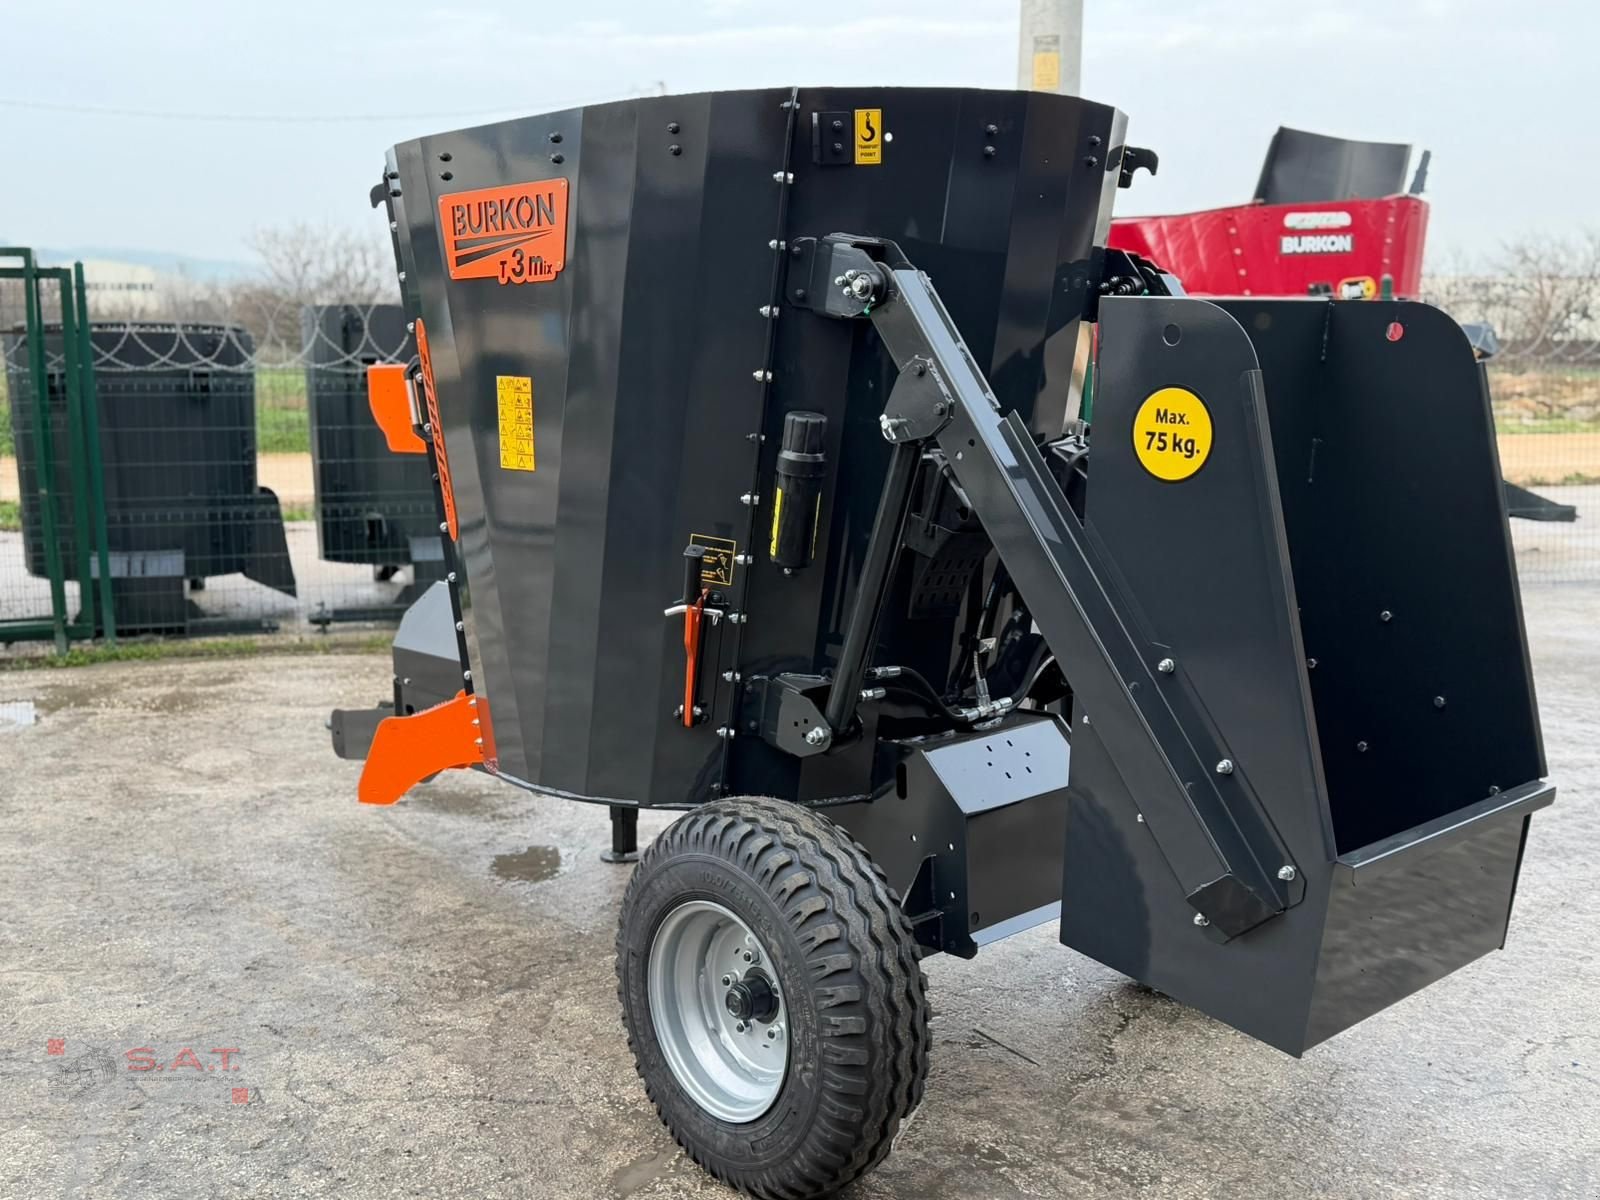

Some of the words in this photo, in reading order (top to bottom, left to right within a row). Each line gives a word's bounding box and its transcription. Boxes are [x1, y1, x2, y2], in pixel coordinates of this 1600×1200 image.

[451, 192, 555, 236] BURKON
[1281, 234, 1352, 254] BURKON
[1155, 408, 1190, 425] Max.
[1145, 431, 1168, 452] 75
[1172, 433, 1200, 459] kg.
